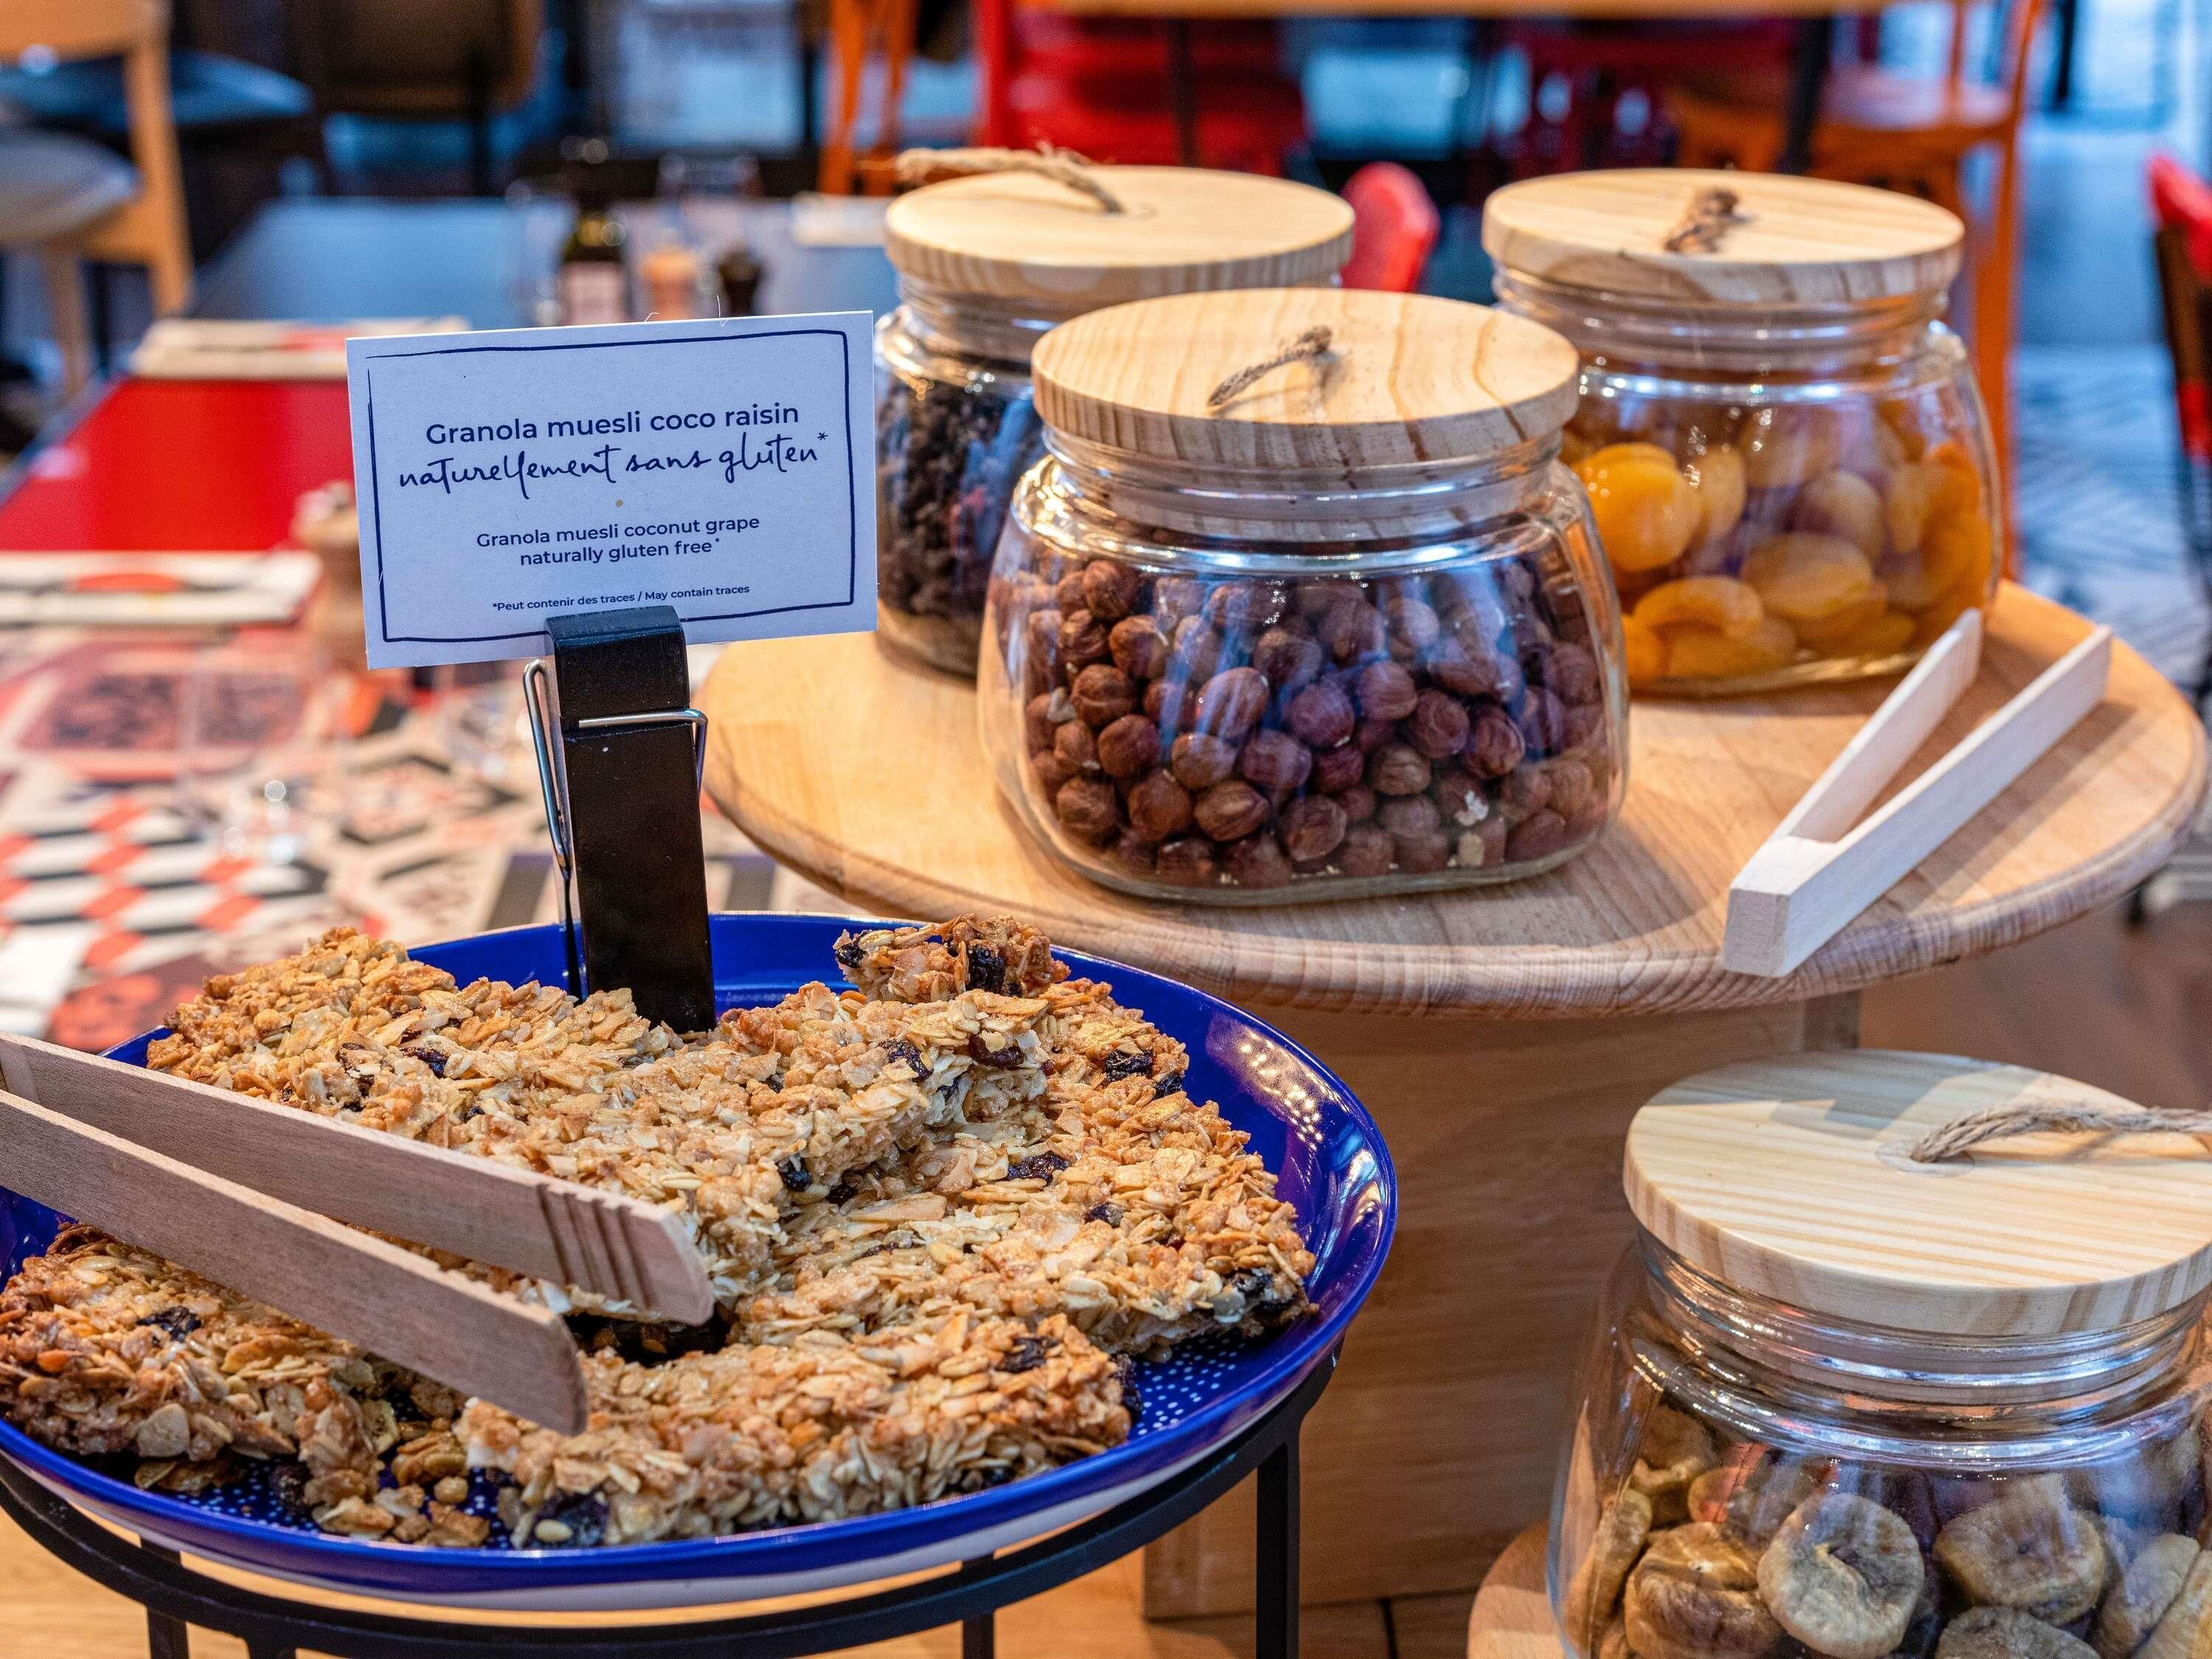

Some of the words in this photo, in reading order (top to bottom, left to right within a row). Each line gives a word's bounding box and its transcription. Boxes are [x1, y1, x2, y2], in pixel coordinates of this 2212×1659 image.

[425, 418, 538, 445] Granola
[547, 410, 641, 438] muesli
[650, 412, 716, 431] coco
[725, 402, 799, 427] raisin
[400, 442, 622, 500] naturellement
[625, 450, 712, 473] sans
[476, 529, 550, 547] Granola
[556, 523, 619, 542] muesli
[624, 519, 701, 538] coconut
[705, 518, 760, 535] grape
[520, 546, 604, 566] naturally
[608, 543, 669, 563] gluten
[526, 597, 575, 609] contenir
[577, 596, 598, 605] des
[599, 594, 636, 604] traces
[637, 590, 643, 602] /
[644, 591, 669, 601] May
[670, 587, 712, 599] contain
[714, 586, 750, 595] traces
